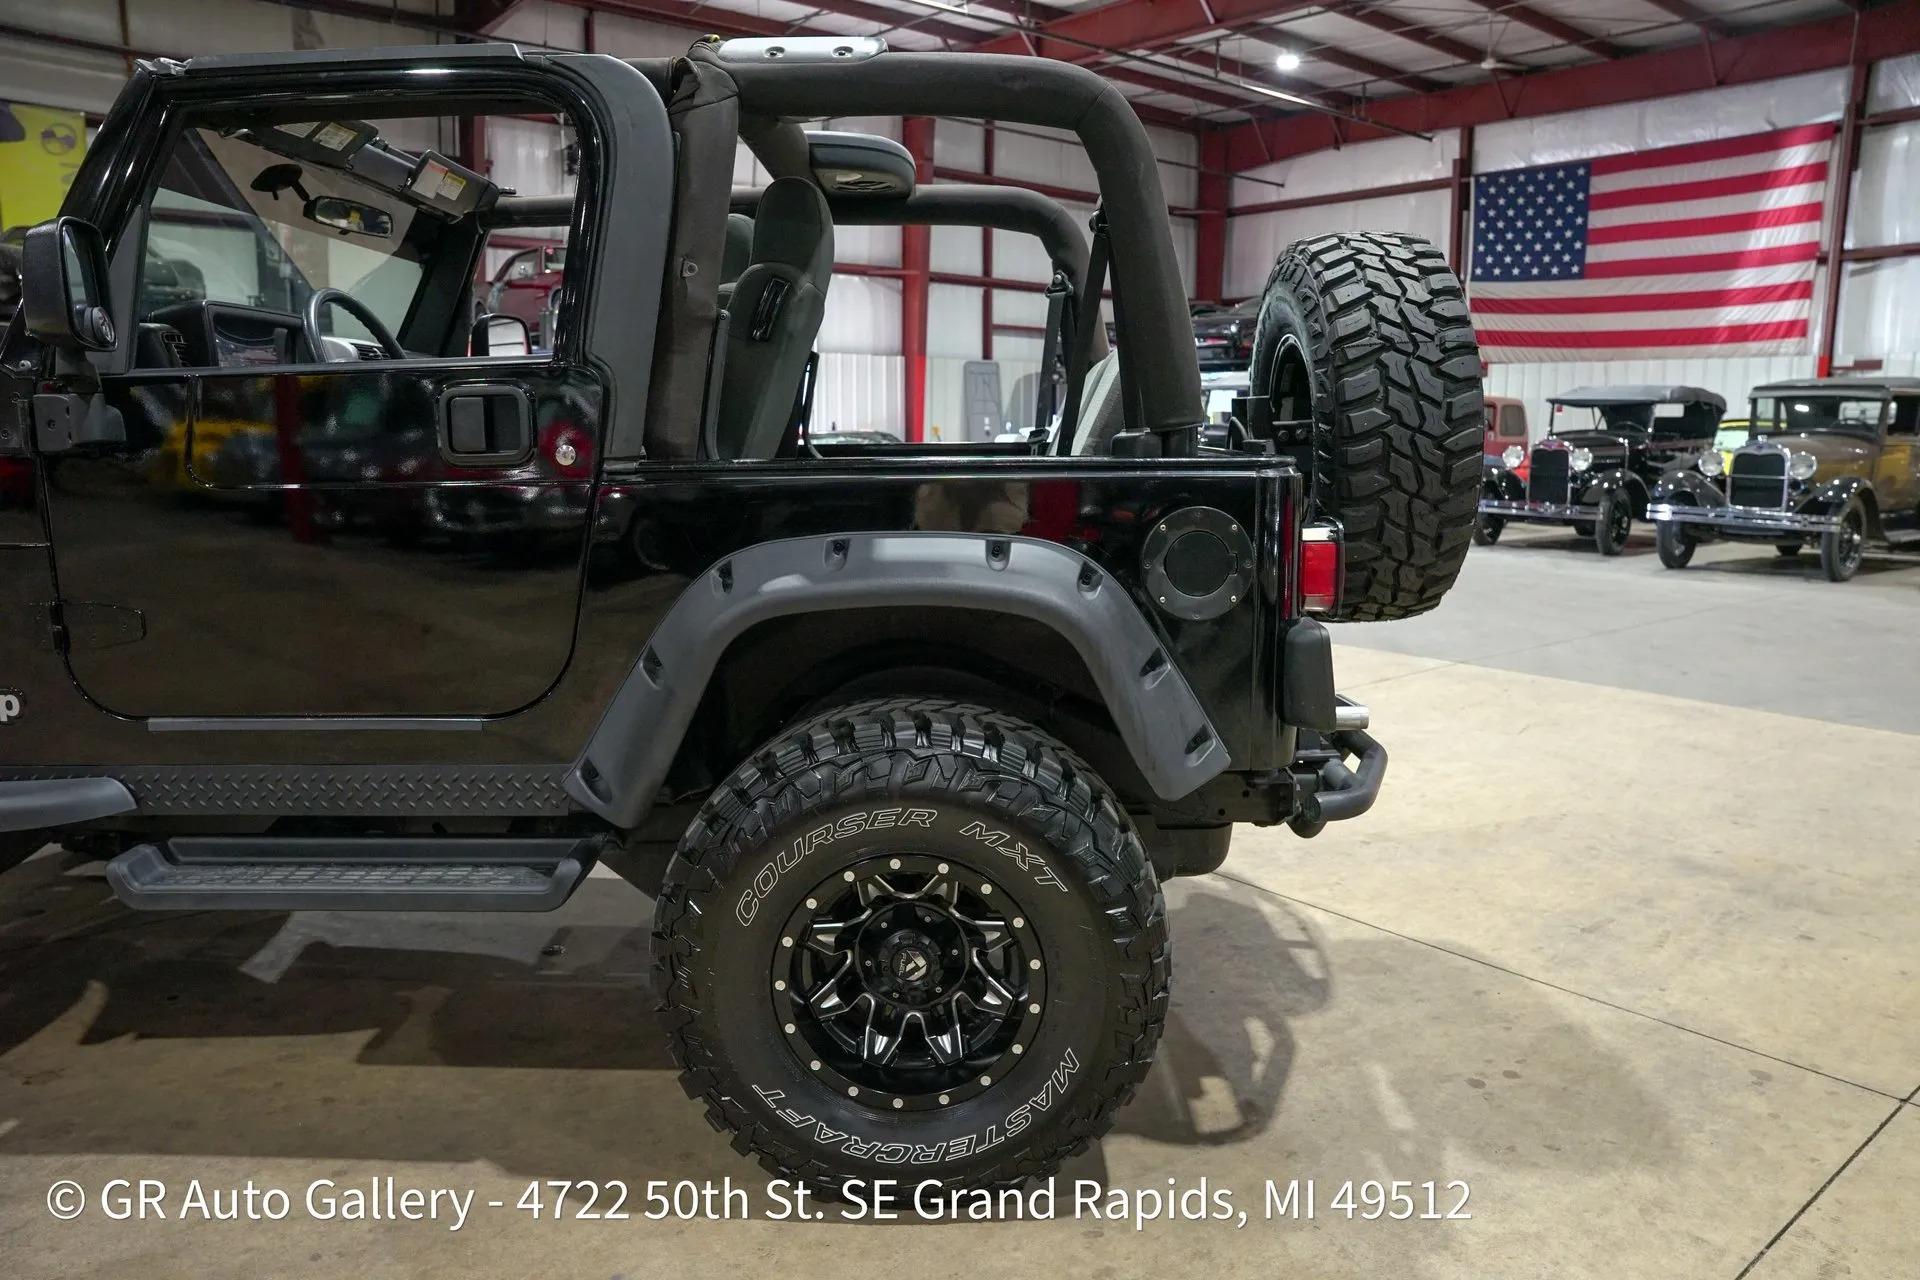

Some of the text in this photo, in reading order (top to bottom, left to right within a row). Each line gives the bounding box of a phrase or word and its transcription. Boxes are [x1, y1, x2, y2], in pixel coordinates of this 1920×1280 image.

[736, 807, 1069, 926] COURSER MXT
[752, 1047, 1081, 1164] MASTERCRAFT
